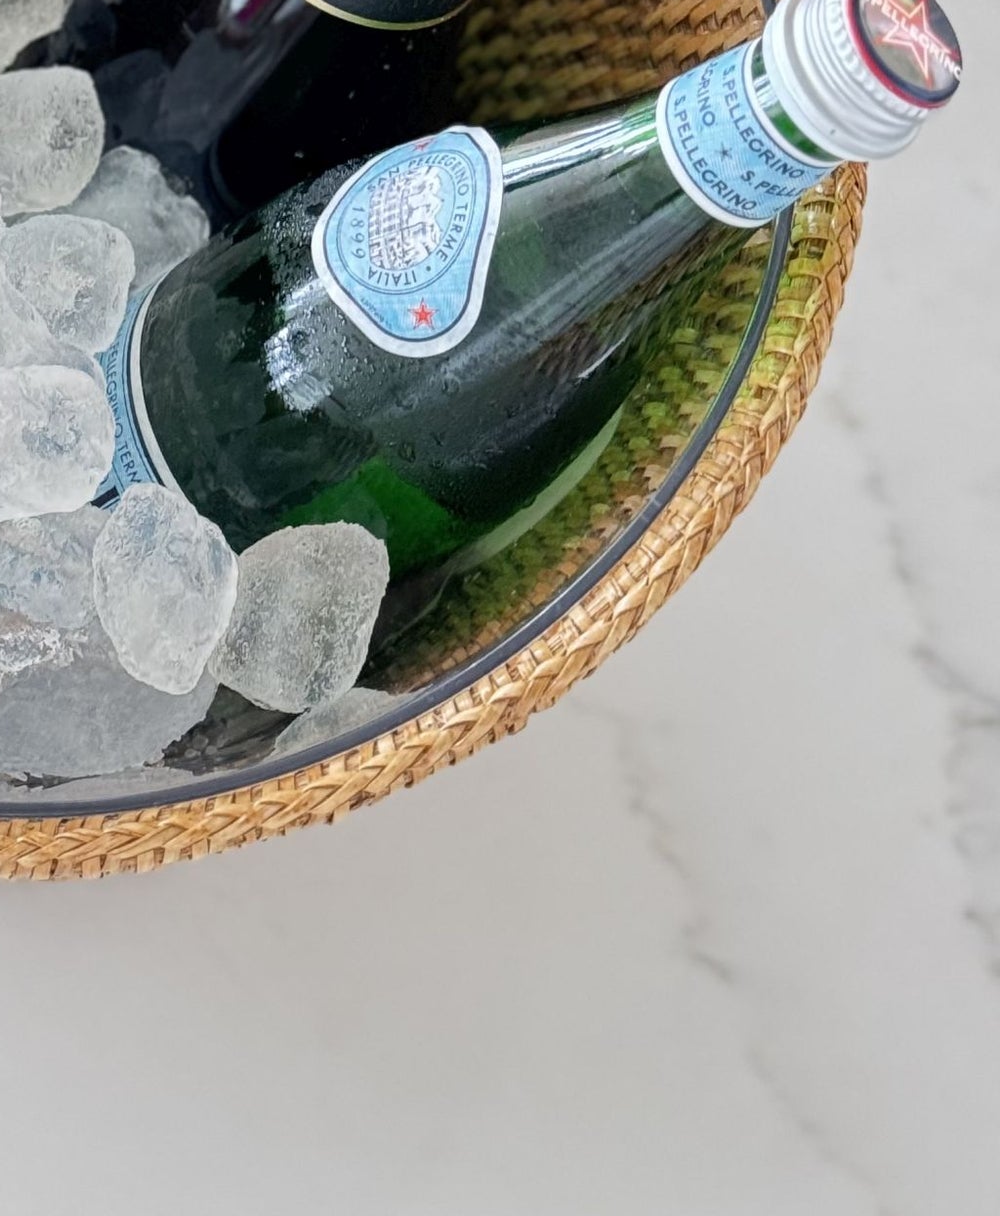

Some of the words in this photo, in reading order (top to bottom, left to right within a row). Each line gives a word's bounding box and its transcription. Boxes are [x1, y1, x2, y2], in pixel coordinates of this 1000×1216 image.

[366, 167, 400, 192] SAN
[408, 153, 470, 197] PELLEGRINO
[351, 205, 366, 260] 1899
[435, 204, 468, 262] TERME
[368, 266, 418, 284] ITALIA
[117, 440, 142, 484] TERM
